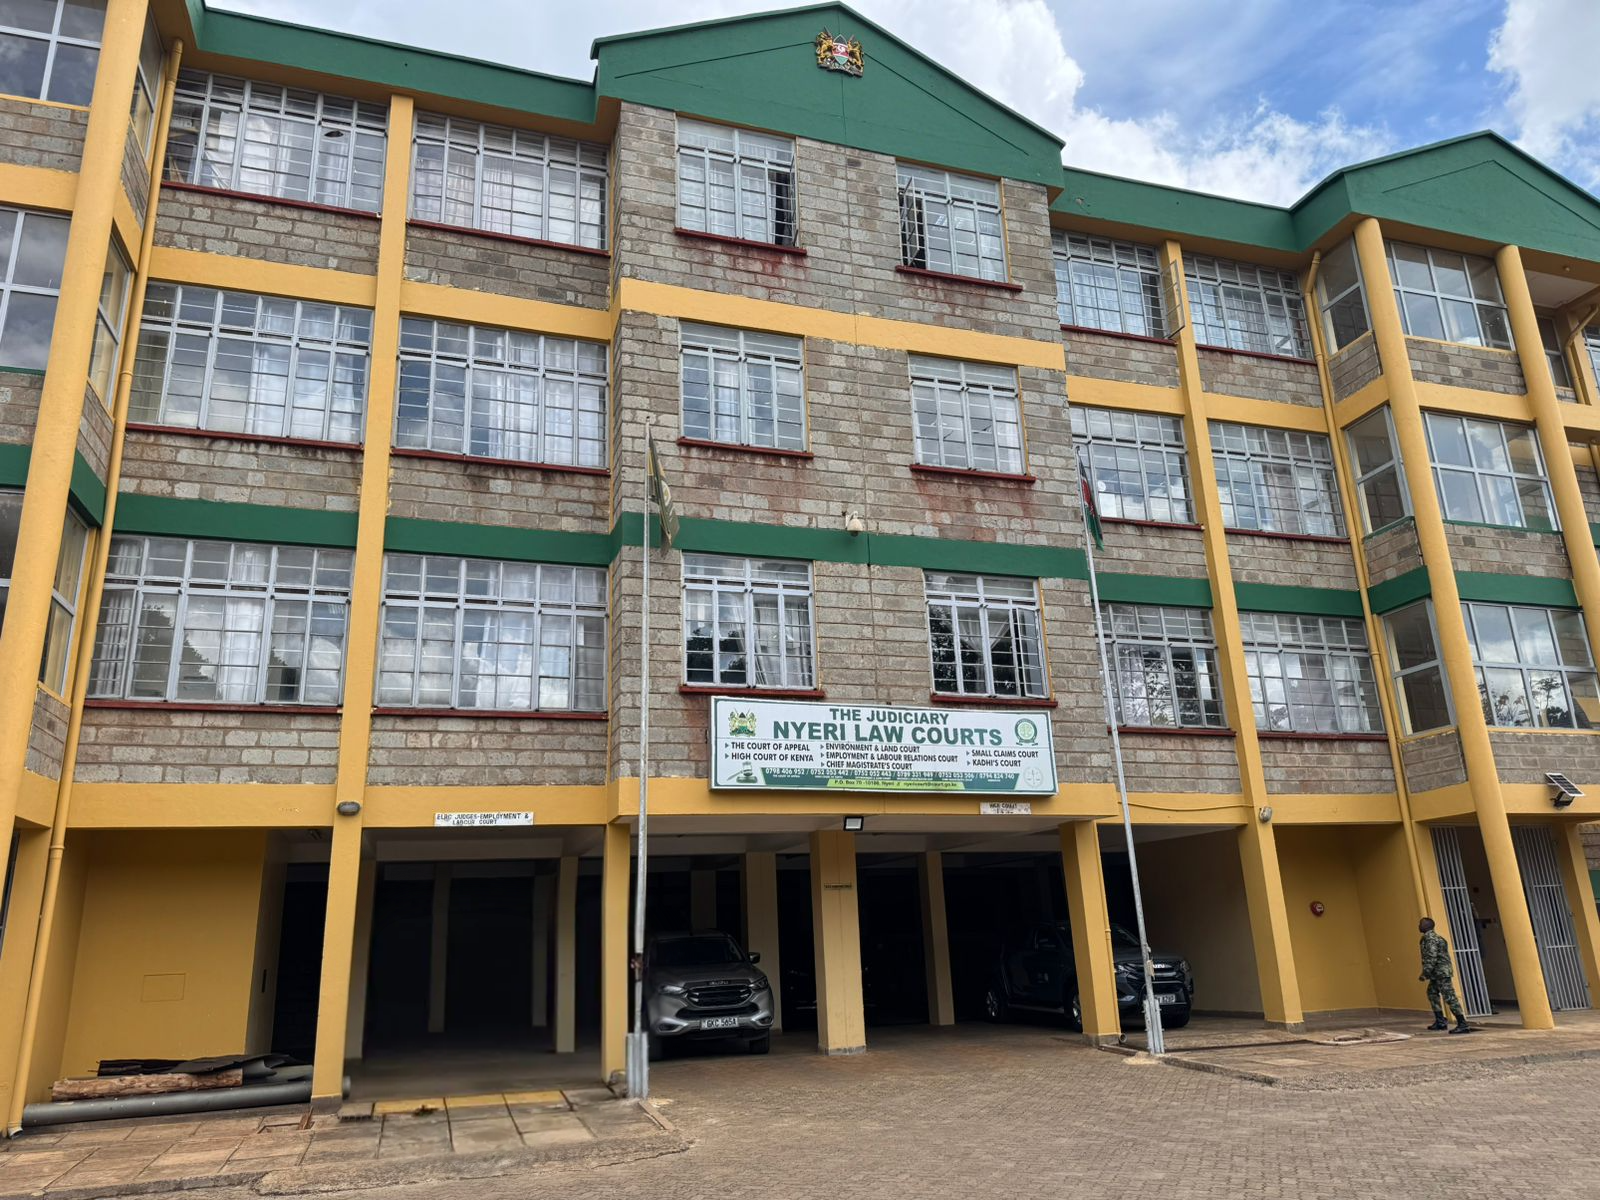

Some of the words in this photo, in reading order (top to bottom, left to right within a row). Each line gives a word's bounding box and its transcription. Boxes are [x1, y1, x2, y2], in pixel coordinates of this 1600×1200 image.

[830, 708, 862, 721] THE
[866, 710, 949, 725] JUDICIARY
[773, 720, 846, 740] NYERI
[854, 724, 904, 742] LAW
[911, 726, 1003, 746] COURTS
[746, 742, 770, 750] COURT
[784, 743, 810, 752] APPEAL
[826, 744, 872, 752] ENVIRONMENT
[846, 761, 890, 770] MAGISTRATE'S
